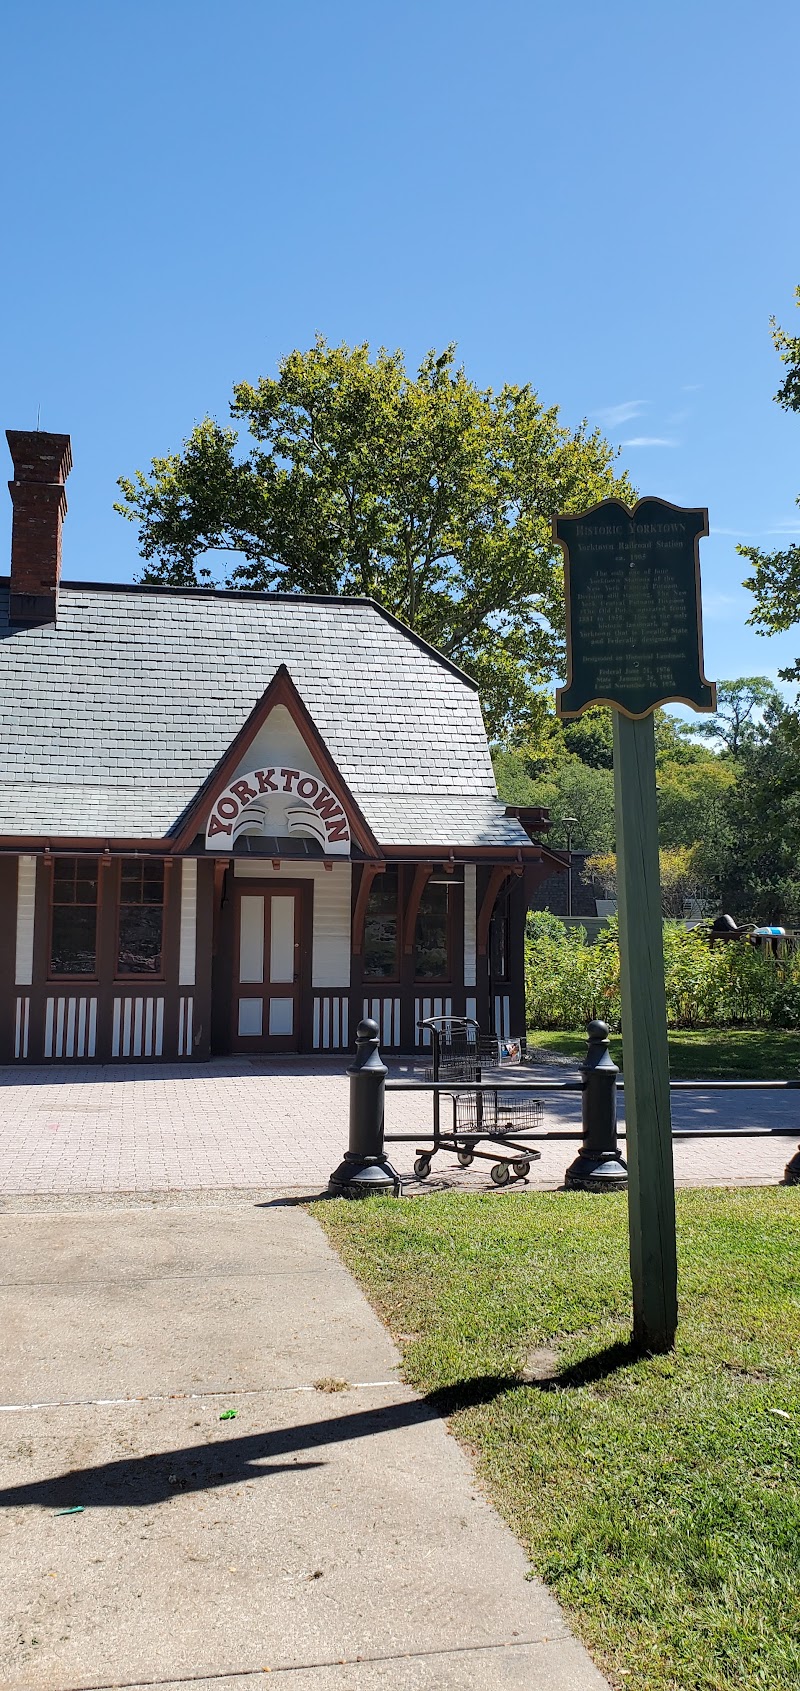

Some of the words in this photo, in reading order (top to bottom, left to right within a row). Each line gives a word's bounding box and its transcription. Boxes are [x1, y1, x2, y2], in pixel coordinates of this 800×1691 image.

[576, 525, 622, 536] HISTORIC
[629, 522, 686, 533] YORKTOWN
[578, 543, 614, 551] Yorktown
[618, 541, 651, 550] Railroad
[656, 539, 683, 548] Station
[207, 769, 350, 843] YORKTOWN
